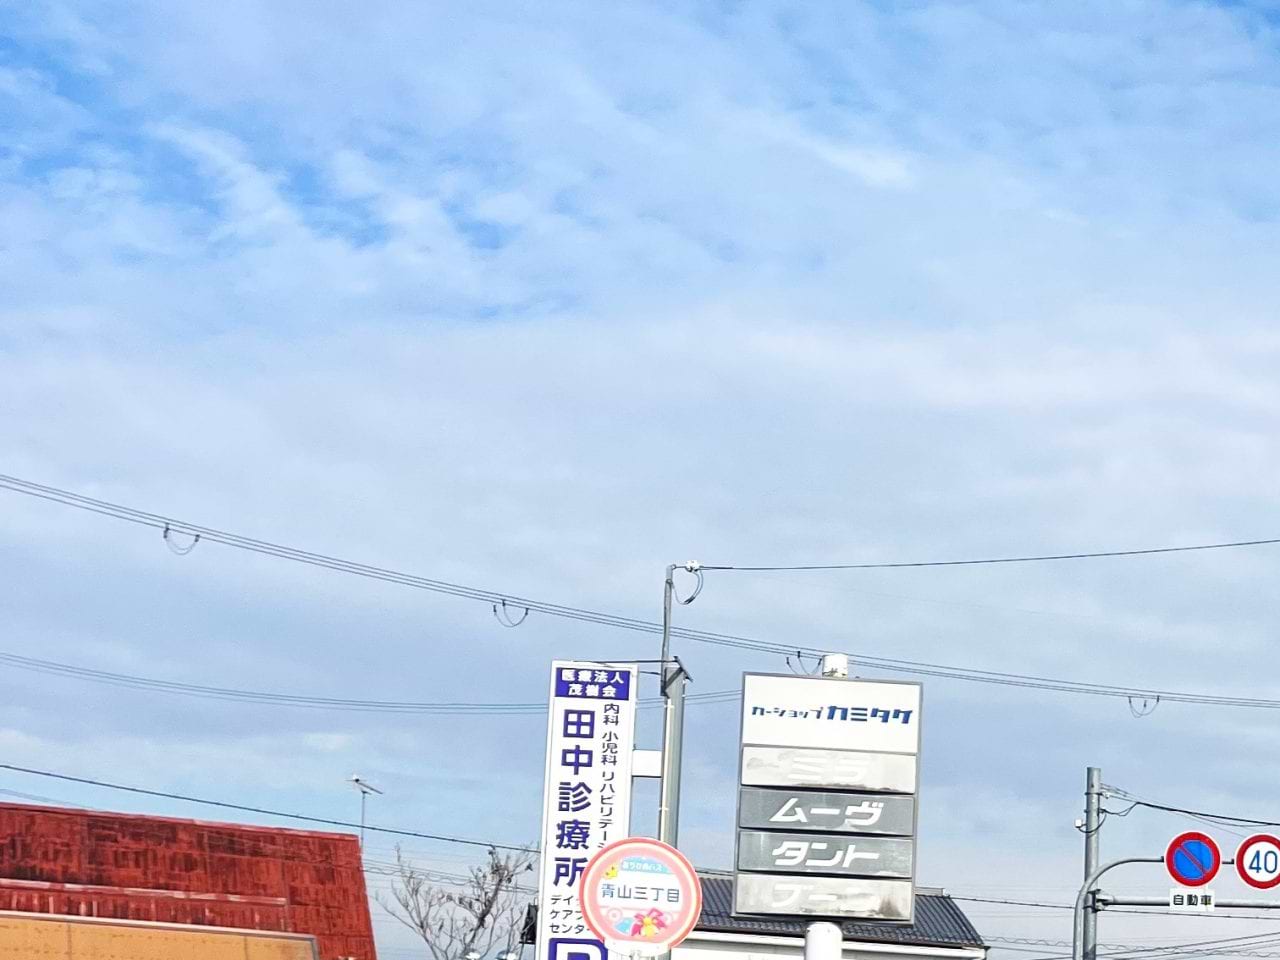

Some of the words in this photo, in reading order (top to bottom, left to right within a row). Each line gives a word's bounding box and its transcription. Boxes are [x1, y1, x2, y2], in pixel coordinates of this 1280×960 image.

[561, 668, 625, 684] 医療法人
[603, 703, 620, 726] 内科
[601, 731, 619, 766] 小児科
[553, 709, 596, 887] 田中診療所
[768, 797, 884, 826] ムーヴ
[771, 840, 880, 868] タント
[1248, 850, 1278, 874] 40
[601, 883, 680, 903] 青山三丁目
[1173, 894, 1212, 906] 自動車
